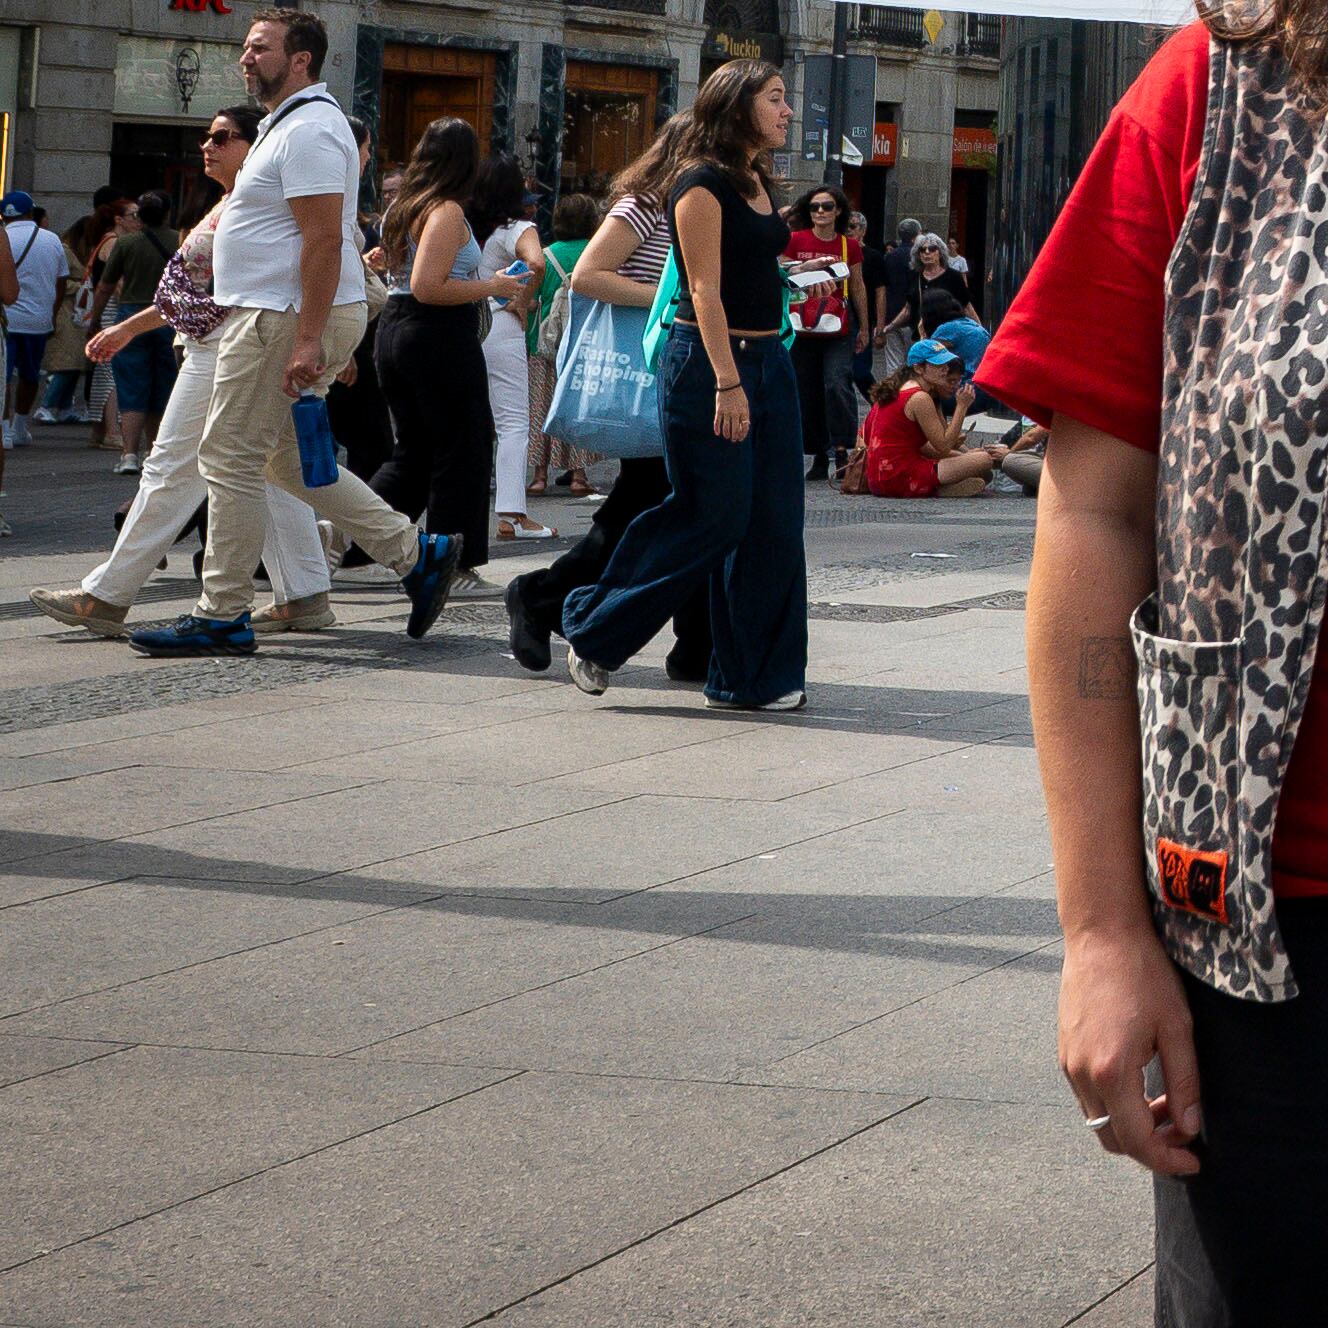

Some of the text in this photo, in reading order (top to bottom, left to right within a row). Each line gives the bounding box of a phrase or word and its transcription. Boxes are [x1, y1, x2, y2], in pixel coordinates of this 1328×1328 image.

[873, 134, 891, 156] kia
[578, 346, 631, 365] Rastro
[573, 363, 655, 388] shopping
